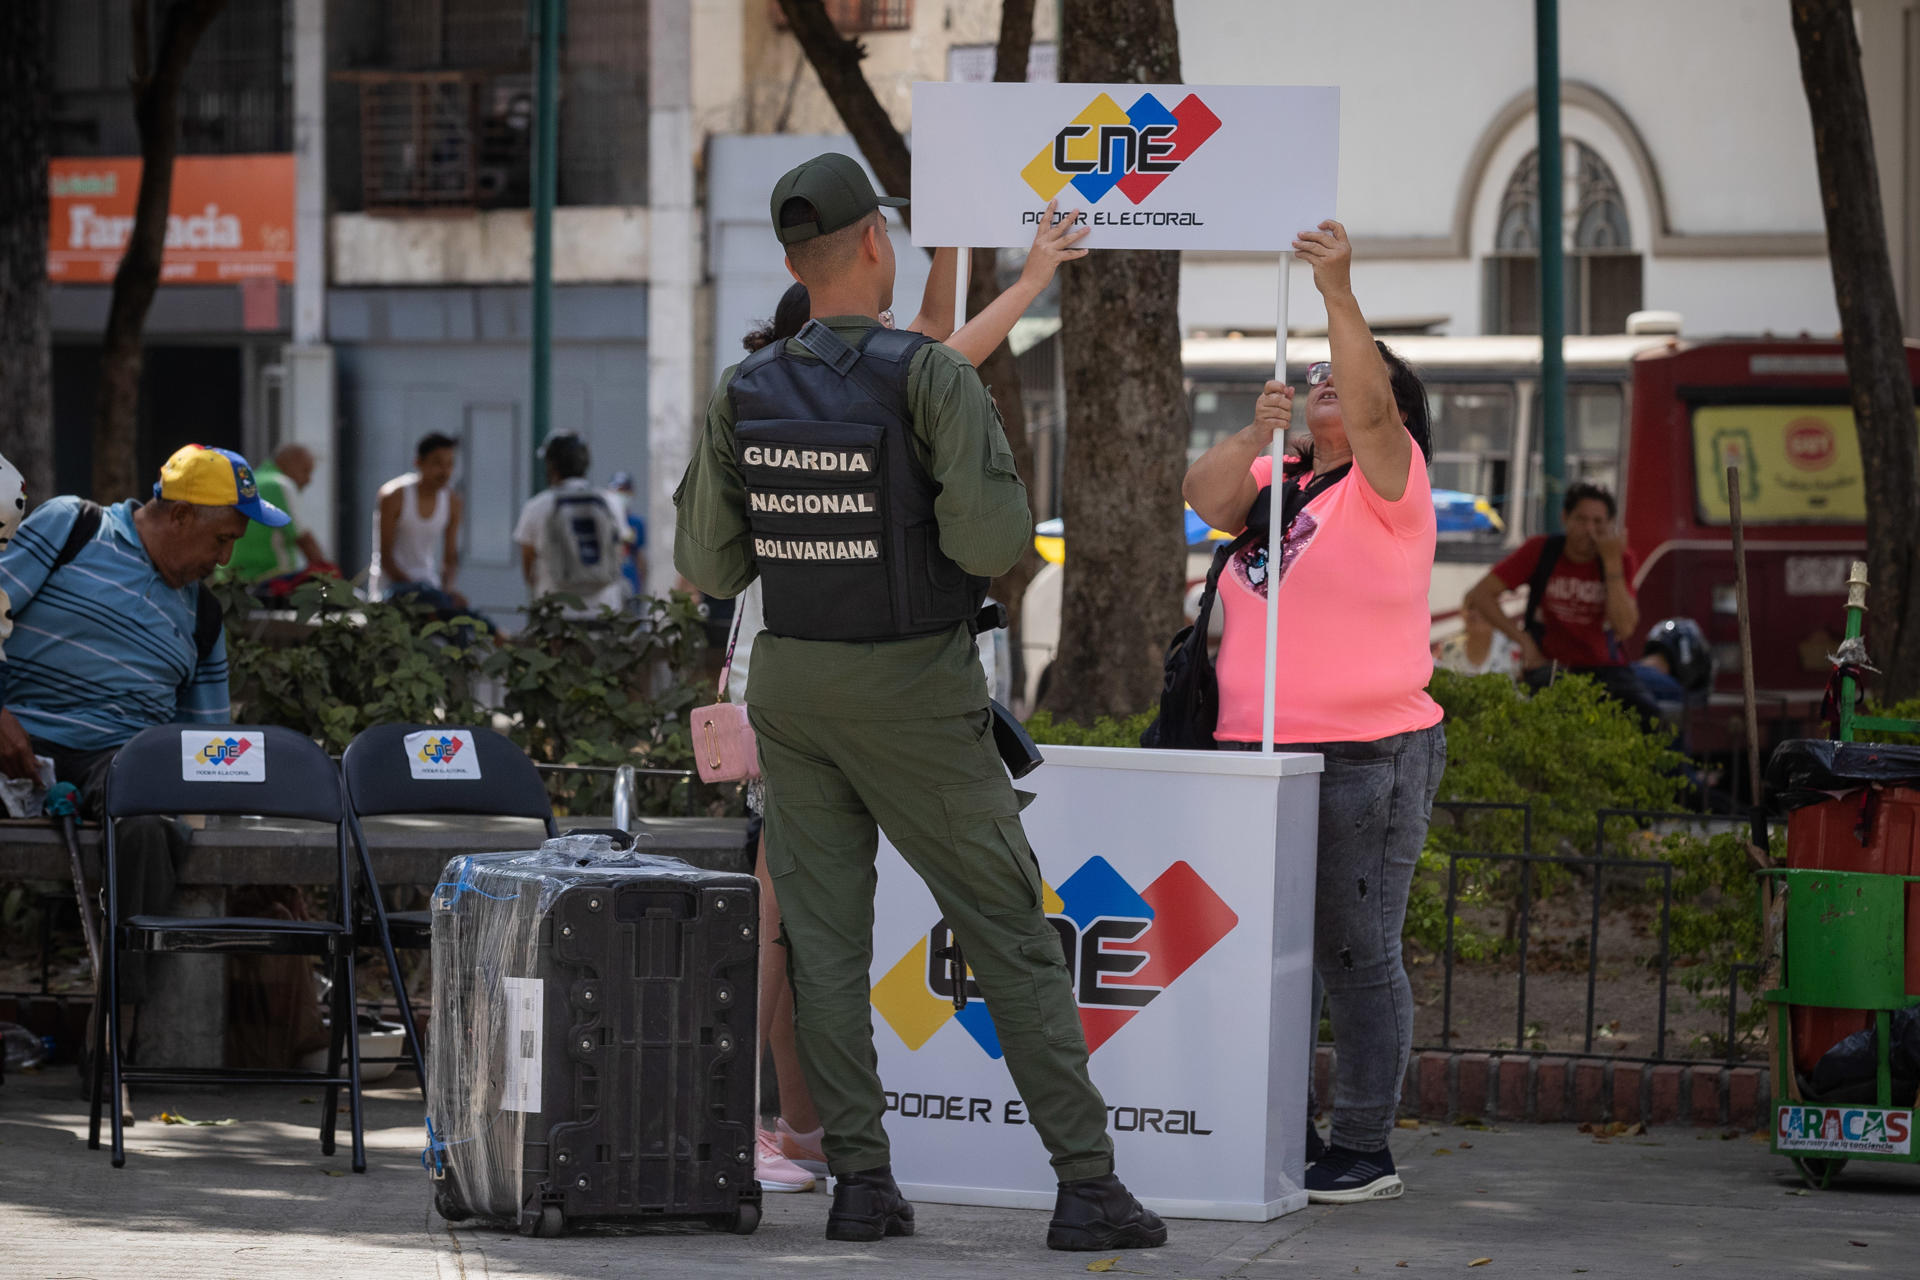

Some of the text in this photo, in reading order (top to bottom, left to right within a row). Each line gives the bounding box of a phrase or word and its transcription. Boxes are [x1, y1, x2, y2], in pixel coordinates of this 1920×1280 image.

[1055, 126, 1182, 173] CNE
[69, 203, 242, 249] Faracia
[1094, 212, 1205, 226] ELECTORAL
[744, 446, 870, 472] GUARDIA
[751, 492, 873, 514] NACIONAL
[754, 538, 878, 560] BOLIVARIANA
[204, 745, 241, 758] CNE
[424, 744, 456, 756] CNE
[884, 1091, 993, 1124] PODER
[1778, 1107, 1909, 1143] CARACAS
